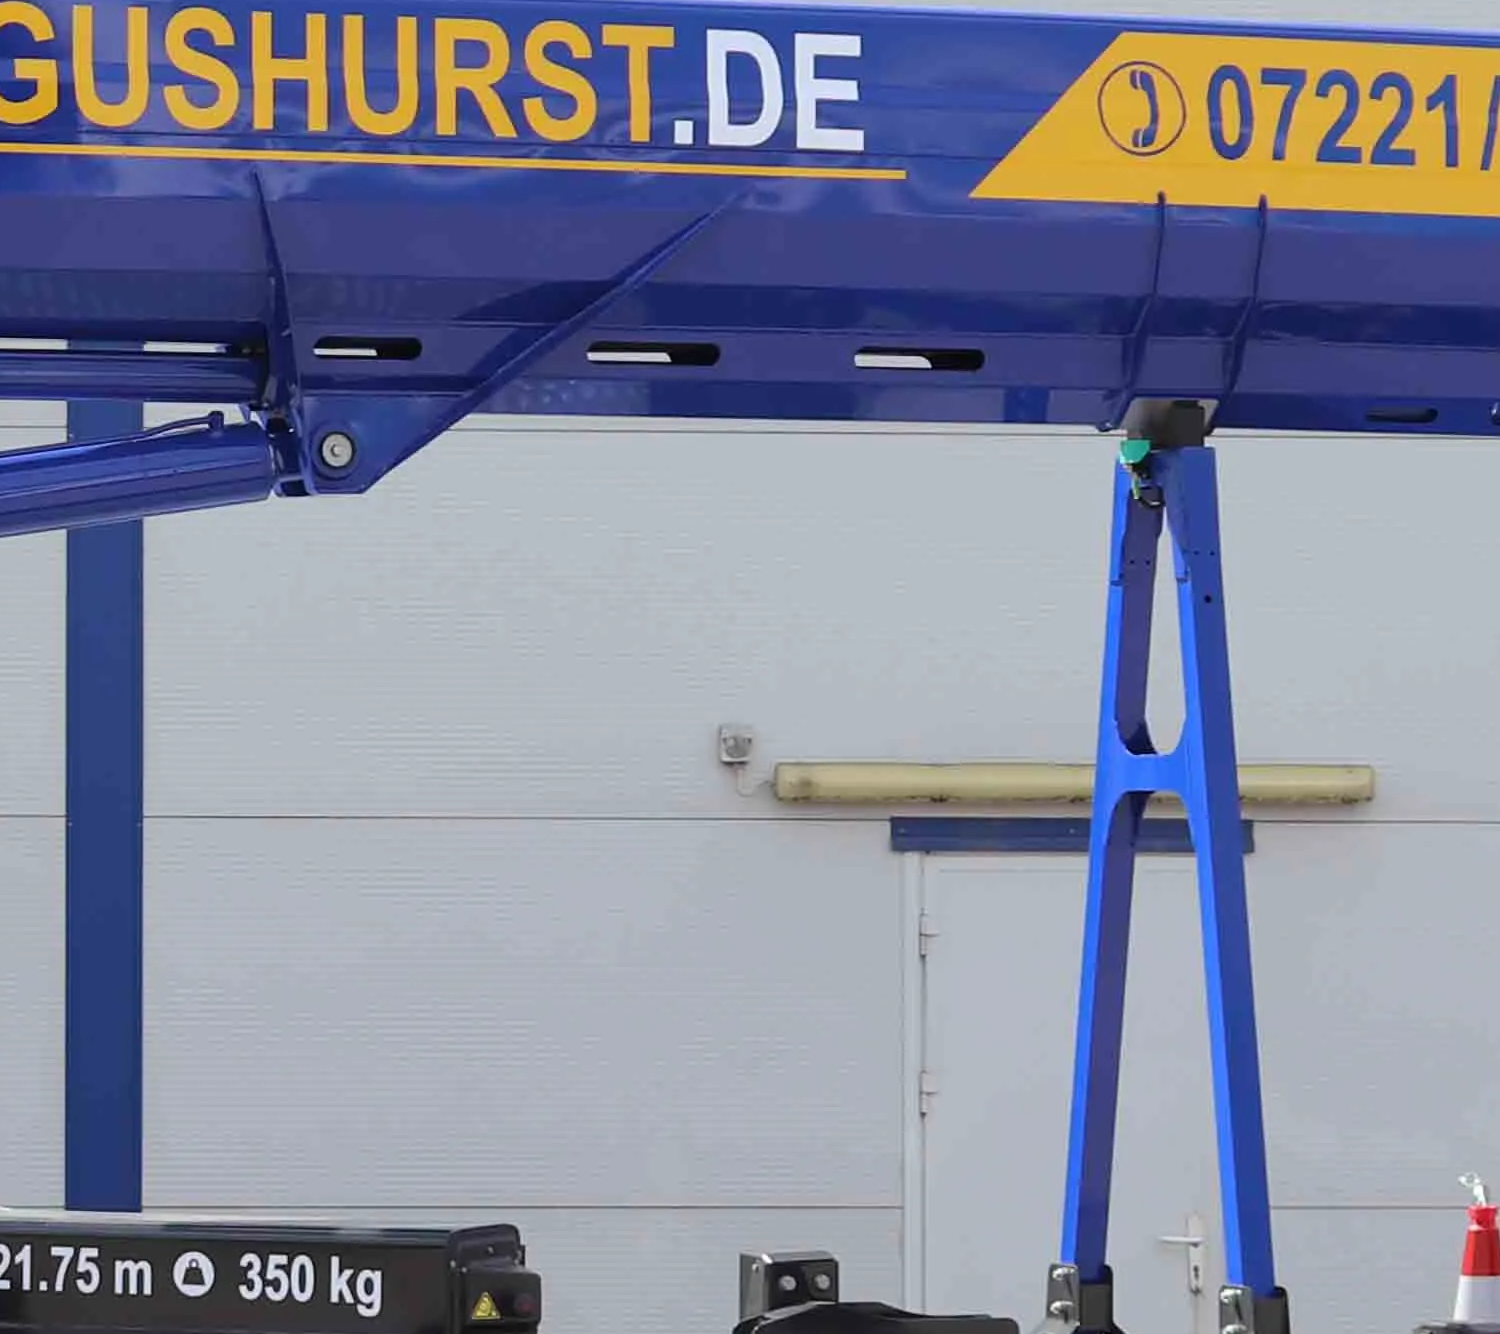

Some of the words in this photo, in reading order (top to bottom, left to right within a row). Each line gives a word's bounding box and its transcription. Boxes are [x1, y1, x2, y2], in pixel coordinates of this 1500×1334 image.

[114, 1257, 152, 1296] m
[238, 1254, 315, 1302] 350
[329, 1256, 383, 1317] kg
